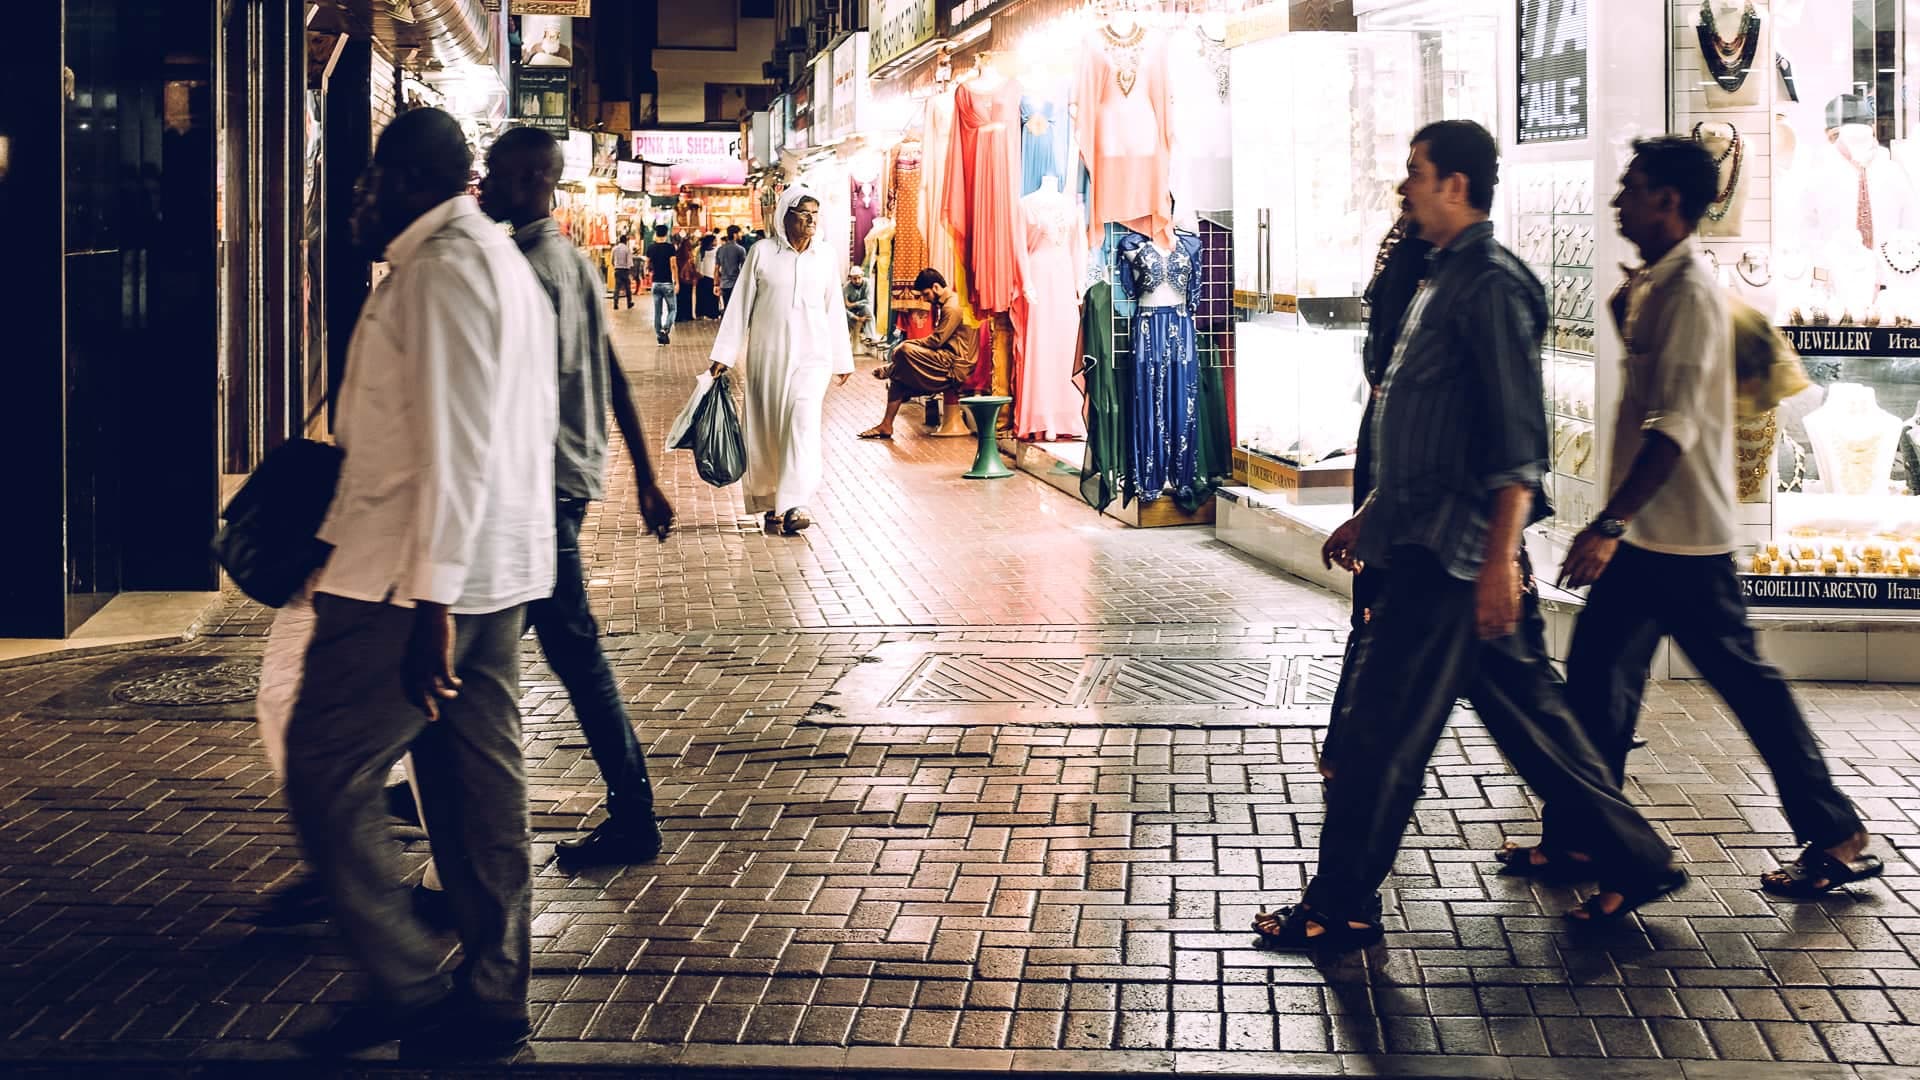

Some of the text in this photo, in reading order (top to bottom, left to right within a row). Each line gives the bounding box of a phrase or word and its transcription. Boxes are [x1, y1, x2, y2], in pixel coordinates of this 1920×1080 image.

[636, 136, 664, 154] PINK
[668, 137, 682, 154] AL
[687, 136, 725, 155] SHELA
[1797, 331, 1873, 351] JEWELLERY
[1888, 333, 1920, 349] Ита
[1754, 580, 1806, 598] GIOIELLI
[1808, 581, 1821, 598] IN
[1822, 582, 1878, 600] ARGENTO
